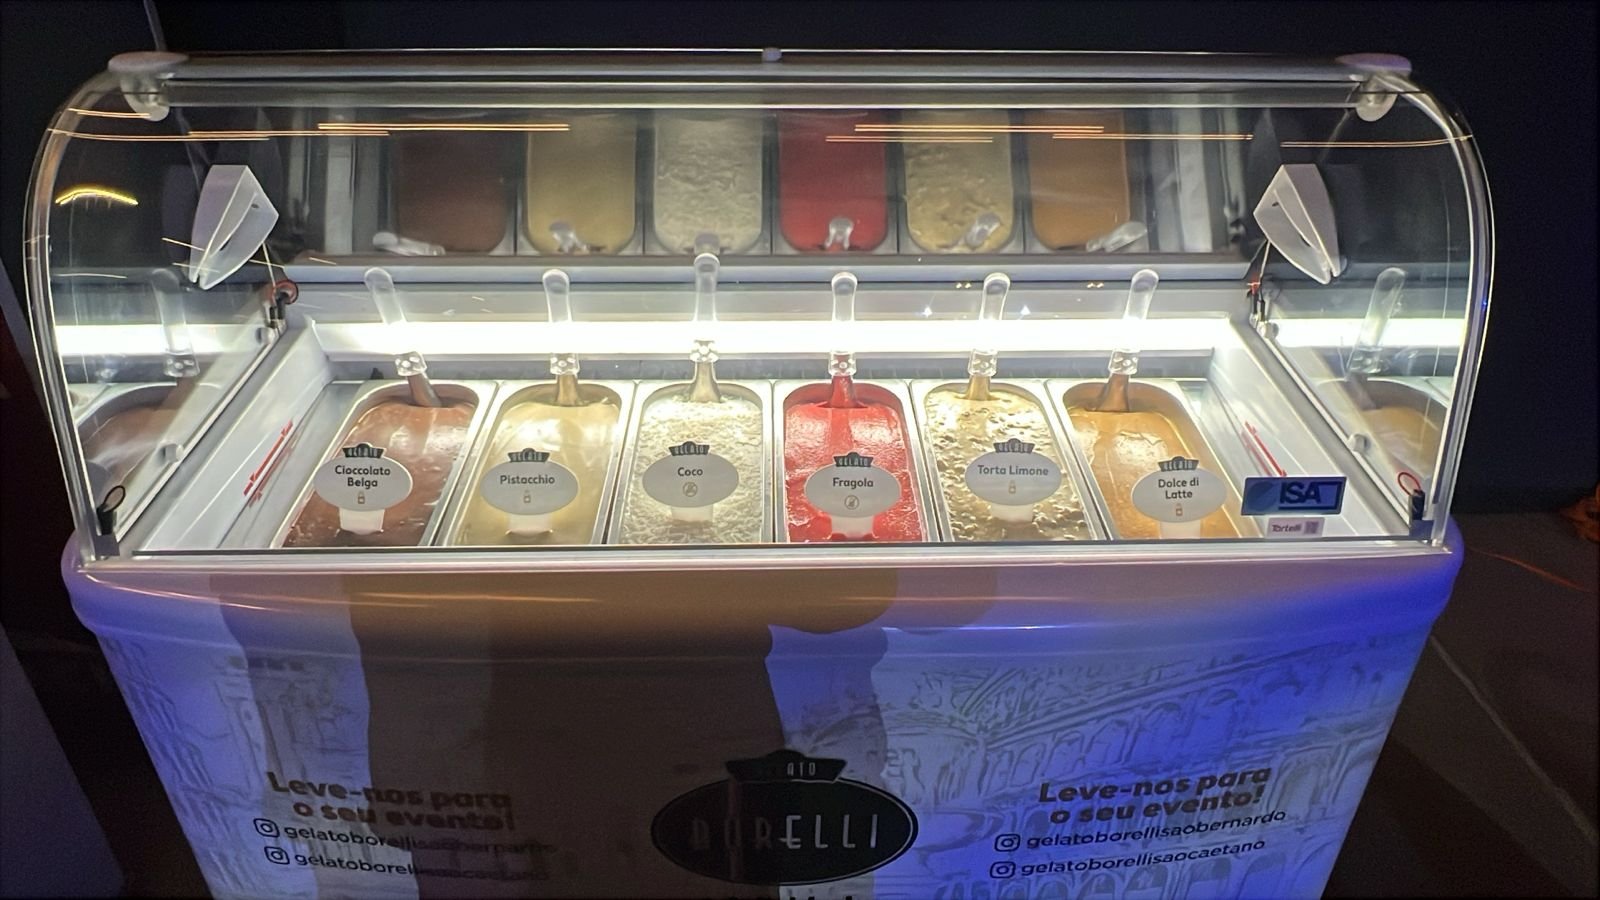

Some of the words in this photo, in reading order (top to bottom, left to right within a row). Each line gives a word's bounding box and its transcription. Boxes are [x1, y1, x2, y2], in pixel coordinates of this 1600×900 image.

[335, 465, 391, 476] Cioccolato
[677, 467, 703, 477] Coco
[977, 465, 1007, 475] Torta
[1009, 465, 1049, 476] Limone
[347, 477, 378, 490] Belga
[500, 475, 555, 485] Pistacchio
[832, 477, 874, 490] Fragola
[1158, 478, 1187, 489] Dolce
[1190, 477, 1200, 487] di
[1165, 490, 1193, 500] Latte
[1280, 481, 1321, 504] ISA
[266, 771, 424, 805] Leve-nos
[430, 791, 512, 811] para
[1039, 777, 1190, 803] Leve-nos
[1196, 768, 1272, 795] para
[1050, 809, 1071, 824] o
[1079, 804, 1136, 822] seu
[1143, 784, 1266, 817] evento!
[293, 802, 313, 818] o
[321, 803, 377, 823] seu
[1027, 810, 1286, 849] gelatoborellisaobernardo
[1021, 840, 1265, 876] gelatoborellisaocaetano
